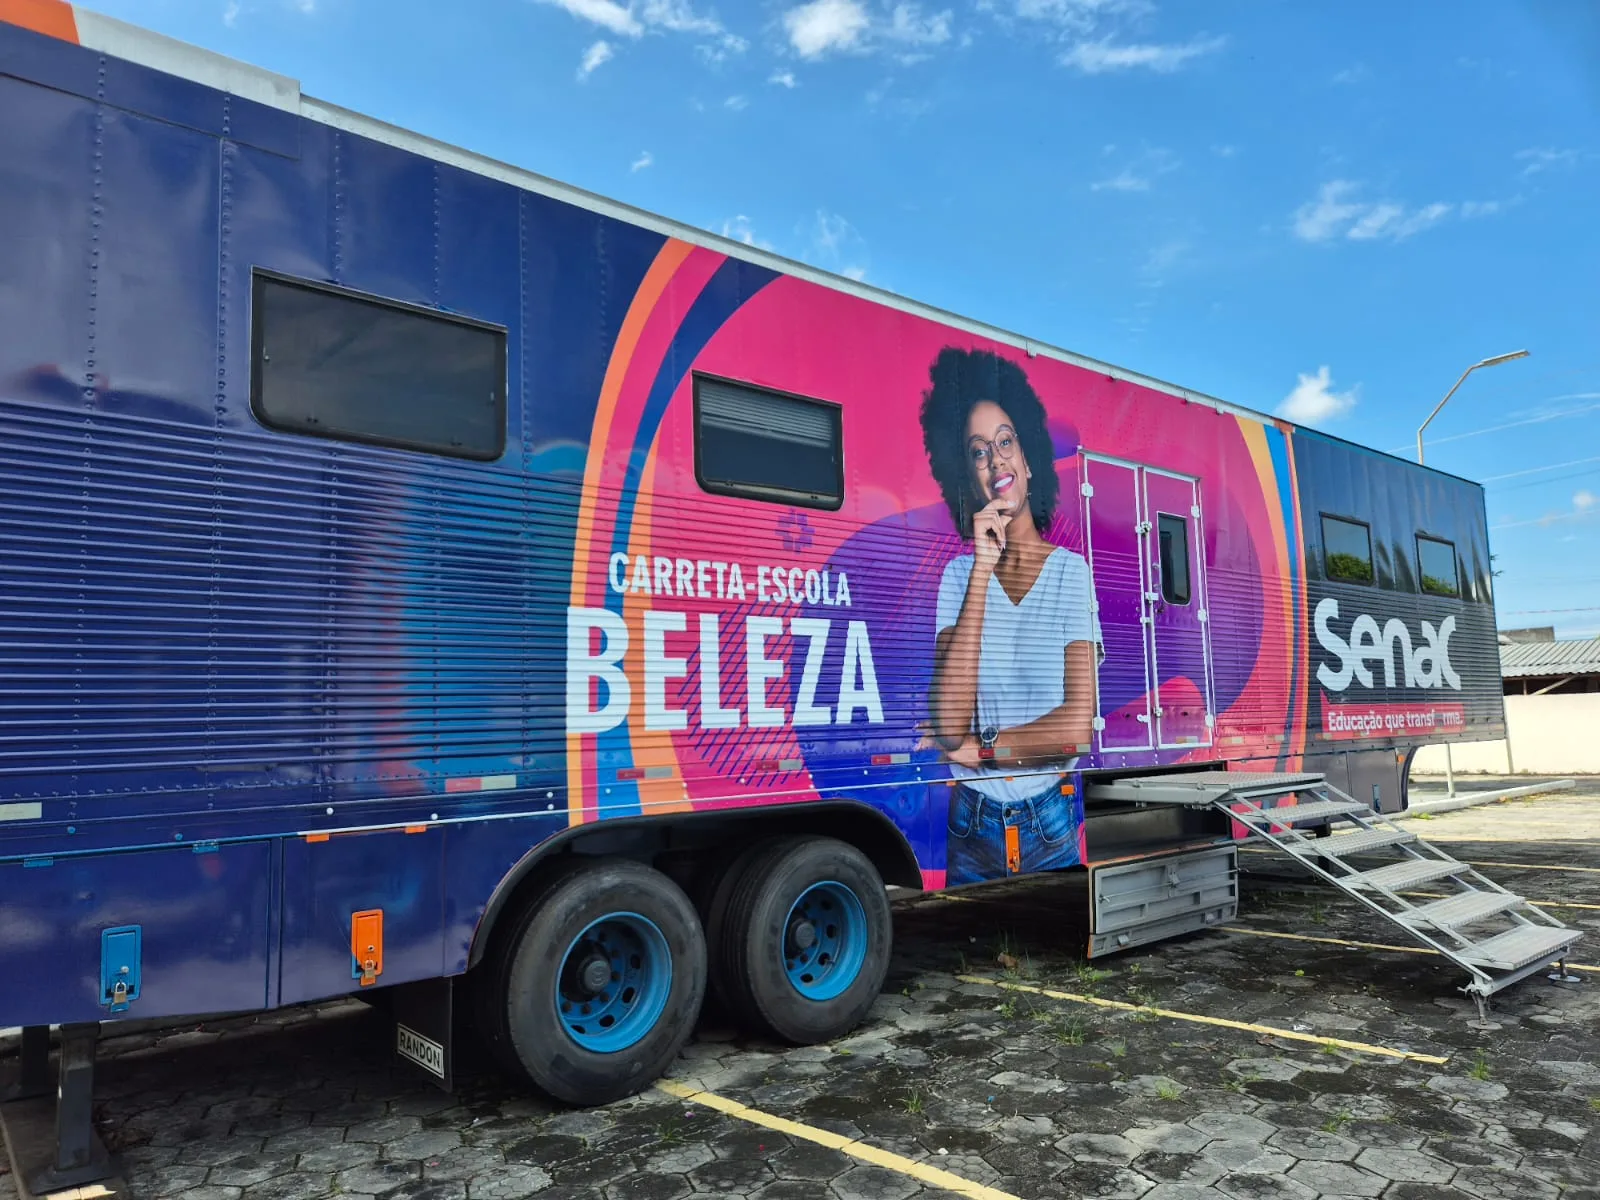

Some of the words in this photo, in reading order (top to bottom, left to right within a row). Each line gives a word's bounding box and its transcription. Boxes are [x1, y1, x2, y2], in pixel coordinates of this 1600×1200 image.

[608, 552, 852, 606] CARRETA-ESCOLA
[565, 606, 884, 735] BELEZA
[1328, 710, 1382, 735] Educação
[1385, 714, 1405, 733] que
[1407, 709, 1463, 727] transfrma.
[400, 1031, 441, 1069] RANDON
